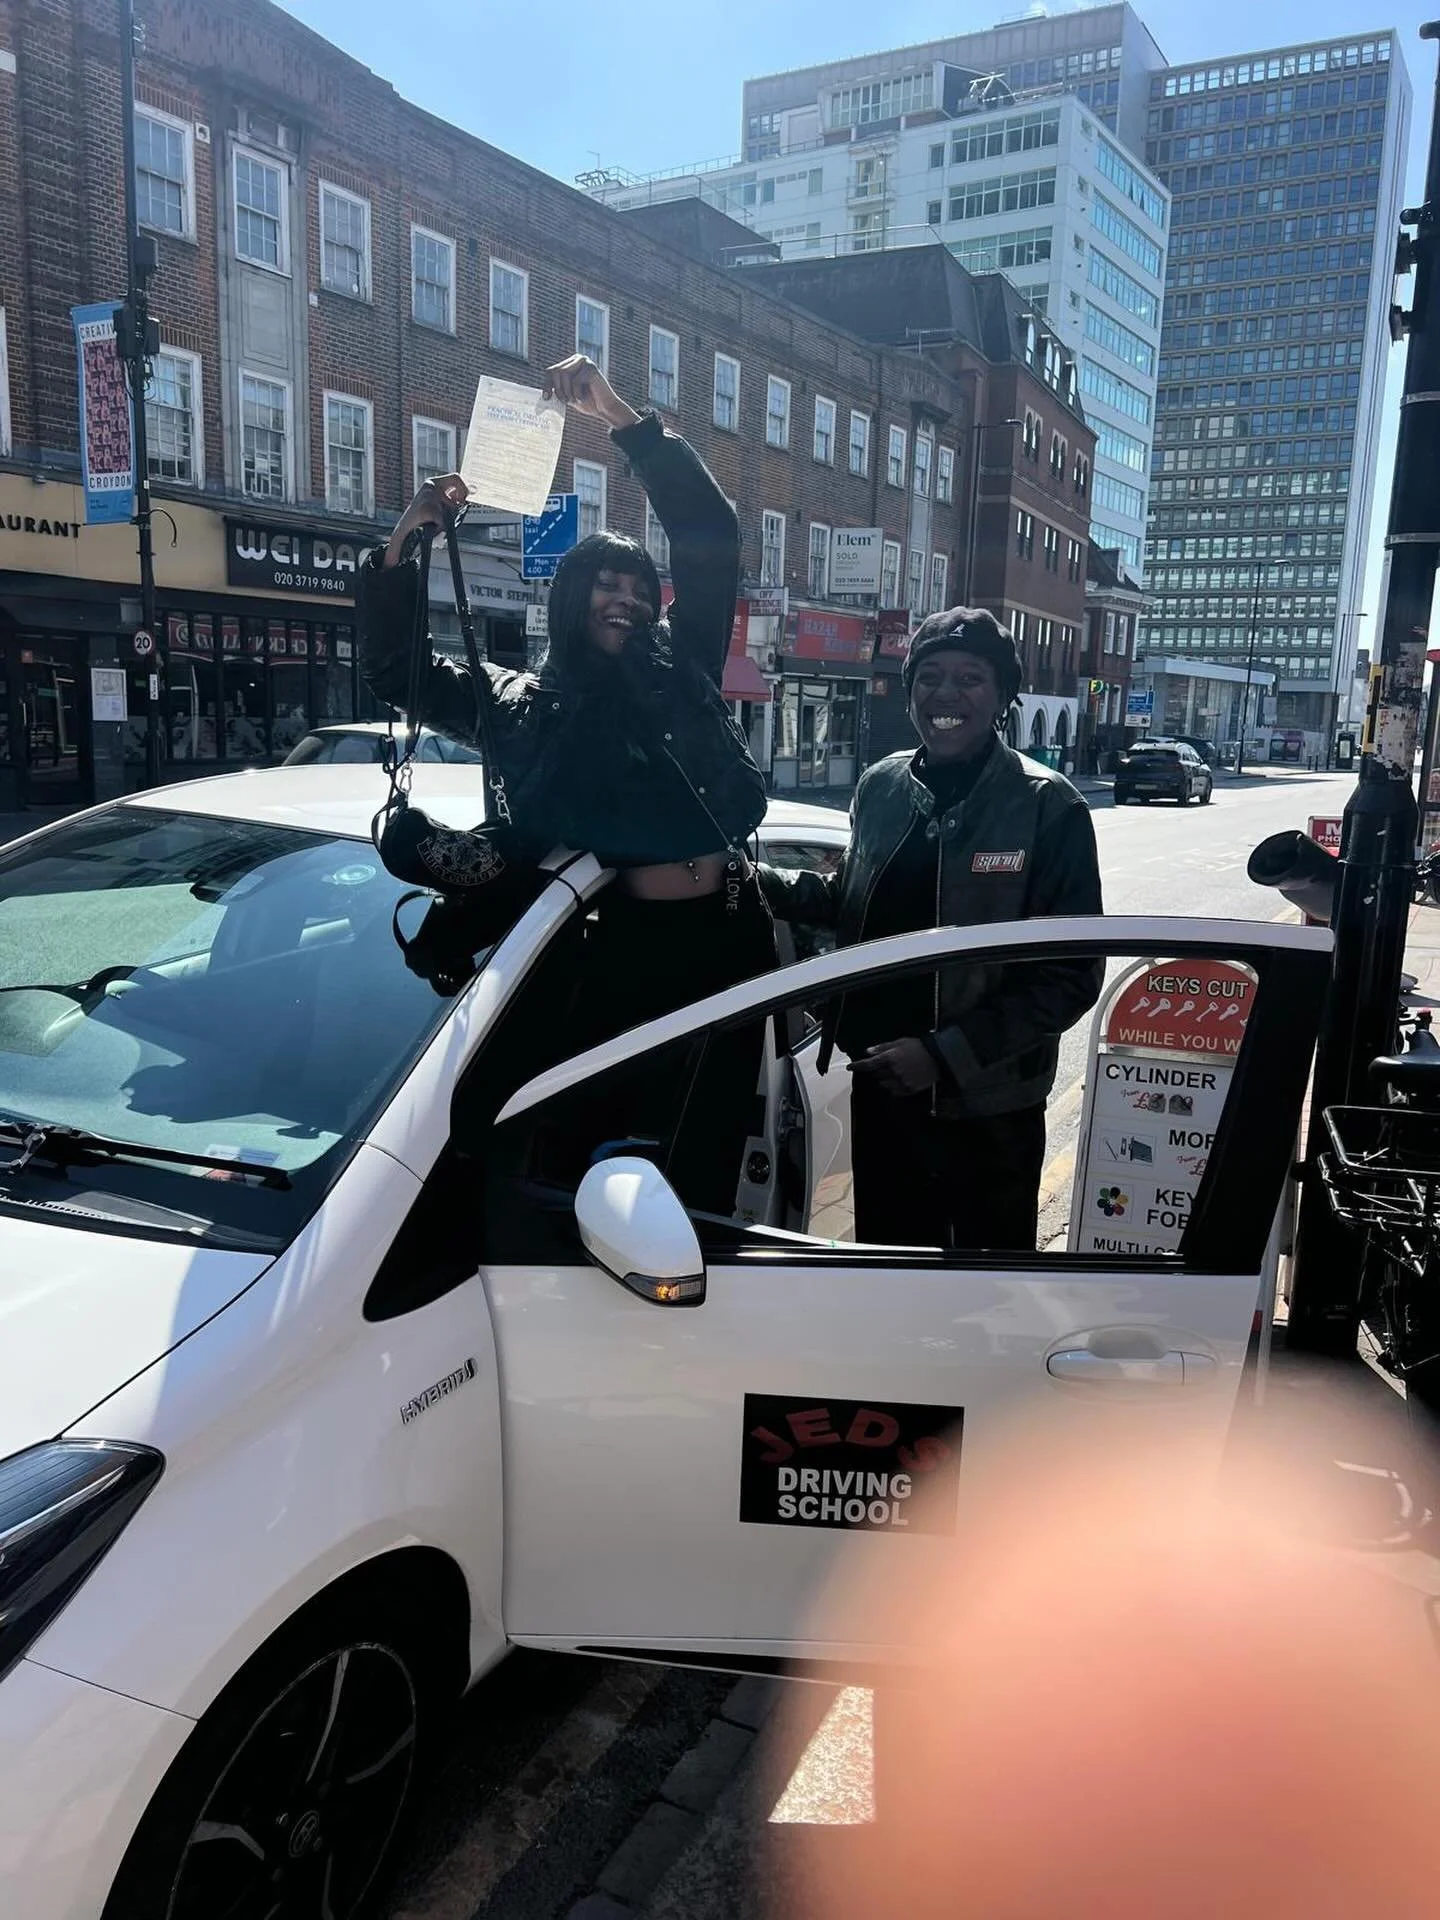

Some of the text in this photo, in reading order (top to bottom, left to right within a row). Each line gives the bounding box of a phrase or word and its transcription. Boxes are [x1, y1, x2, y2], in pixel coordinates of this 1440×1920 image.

[89, 475, 132, 489] CROYDON
[235, 527, 300, 566] WEI
[836, 552, 858, 560] SOLD
[274, 571, 345, 592] 020 3719 9840
[470, 583, 503, 599] VICTOR
[527, 625, 547, 633] came
[534, 616, 548, 624] lan
[135, 636, 150, 648] 20
[1147, 975, 1249, 999] KEYS CUT
[1118, 1027, 1175, 1047] WHILE
[1180, 1033, 1218, 1051] YOU
[1105, 1063, 1217, 1090] CYLINDER
[400, 1358, 478, 1425] HYBRID
[777, 1466, 912, 1499] DRIVING
[777, 1494, 909, 1526] SCHOOL
